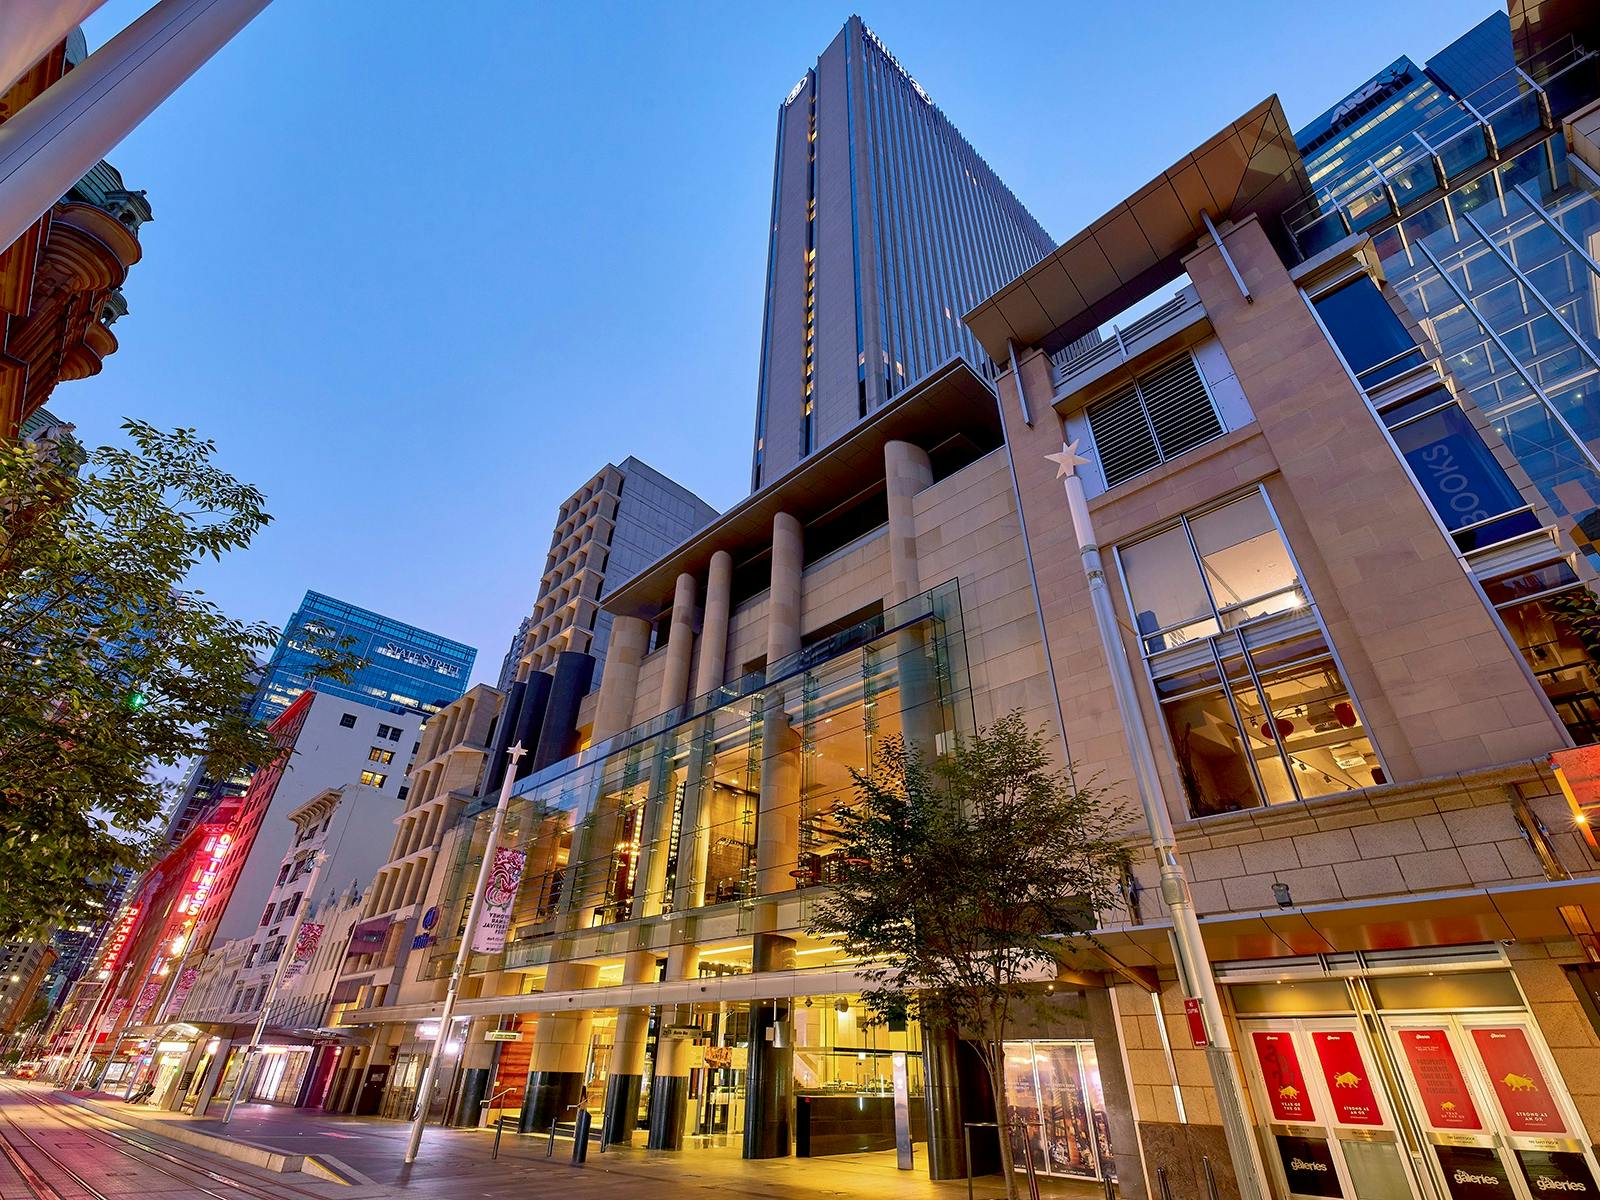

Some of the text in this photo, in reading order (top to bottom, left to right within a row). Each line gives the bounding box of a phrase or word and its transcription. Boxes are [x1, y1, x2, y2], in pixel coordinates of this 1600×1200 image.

[1331, 81, 1383, 124] ANZ
[386, 642, 462, 675] STATE STREET
[104, 908, 139, 970] DYMOCKS
[1454, 1172, 1499, 1185] galeries
[1536, 1178, 1587, 1191] galeries
